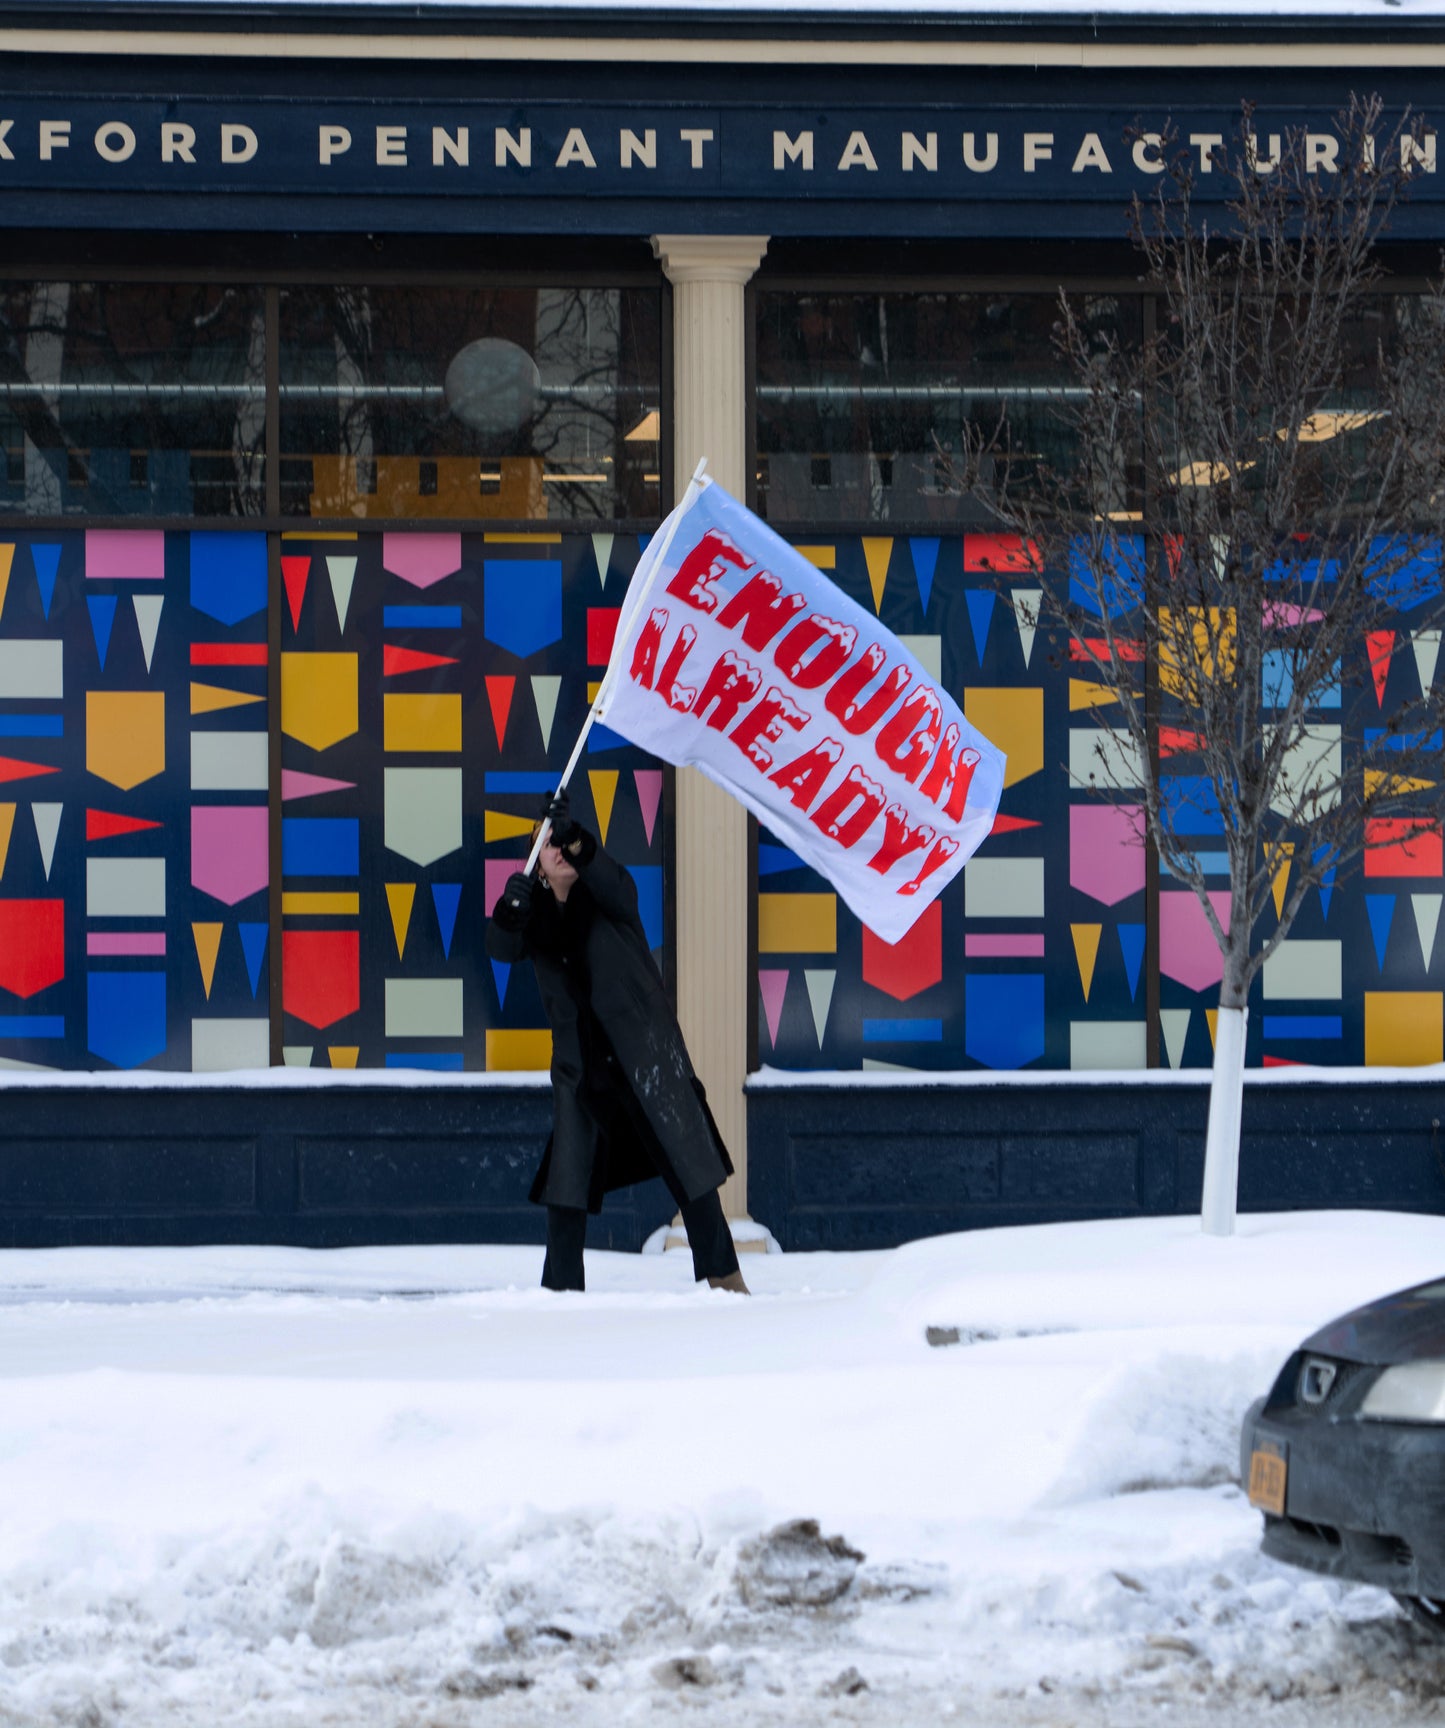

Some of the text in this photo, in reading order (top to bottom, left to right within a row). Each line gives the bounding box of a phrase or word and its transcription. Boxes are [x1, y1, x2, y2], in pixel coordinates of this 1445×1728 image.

[319, 125, 715, 169] PENNANT
[772, 129, 1437, 174] MANUFACTURIN
[629, 607, 961, 896] ALREADY!
[665, 527, 981, 824] ENOUGH
